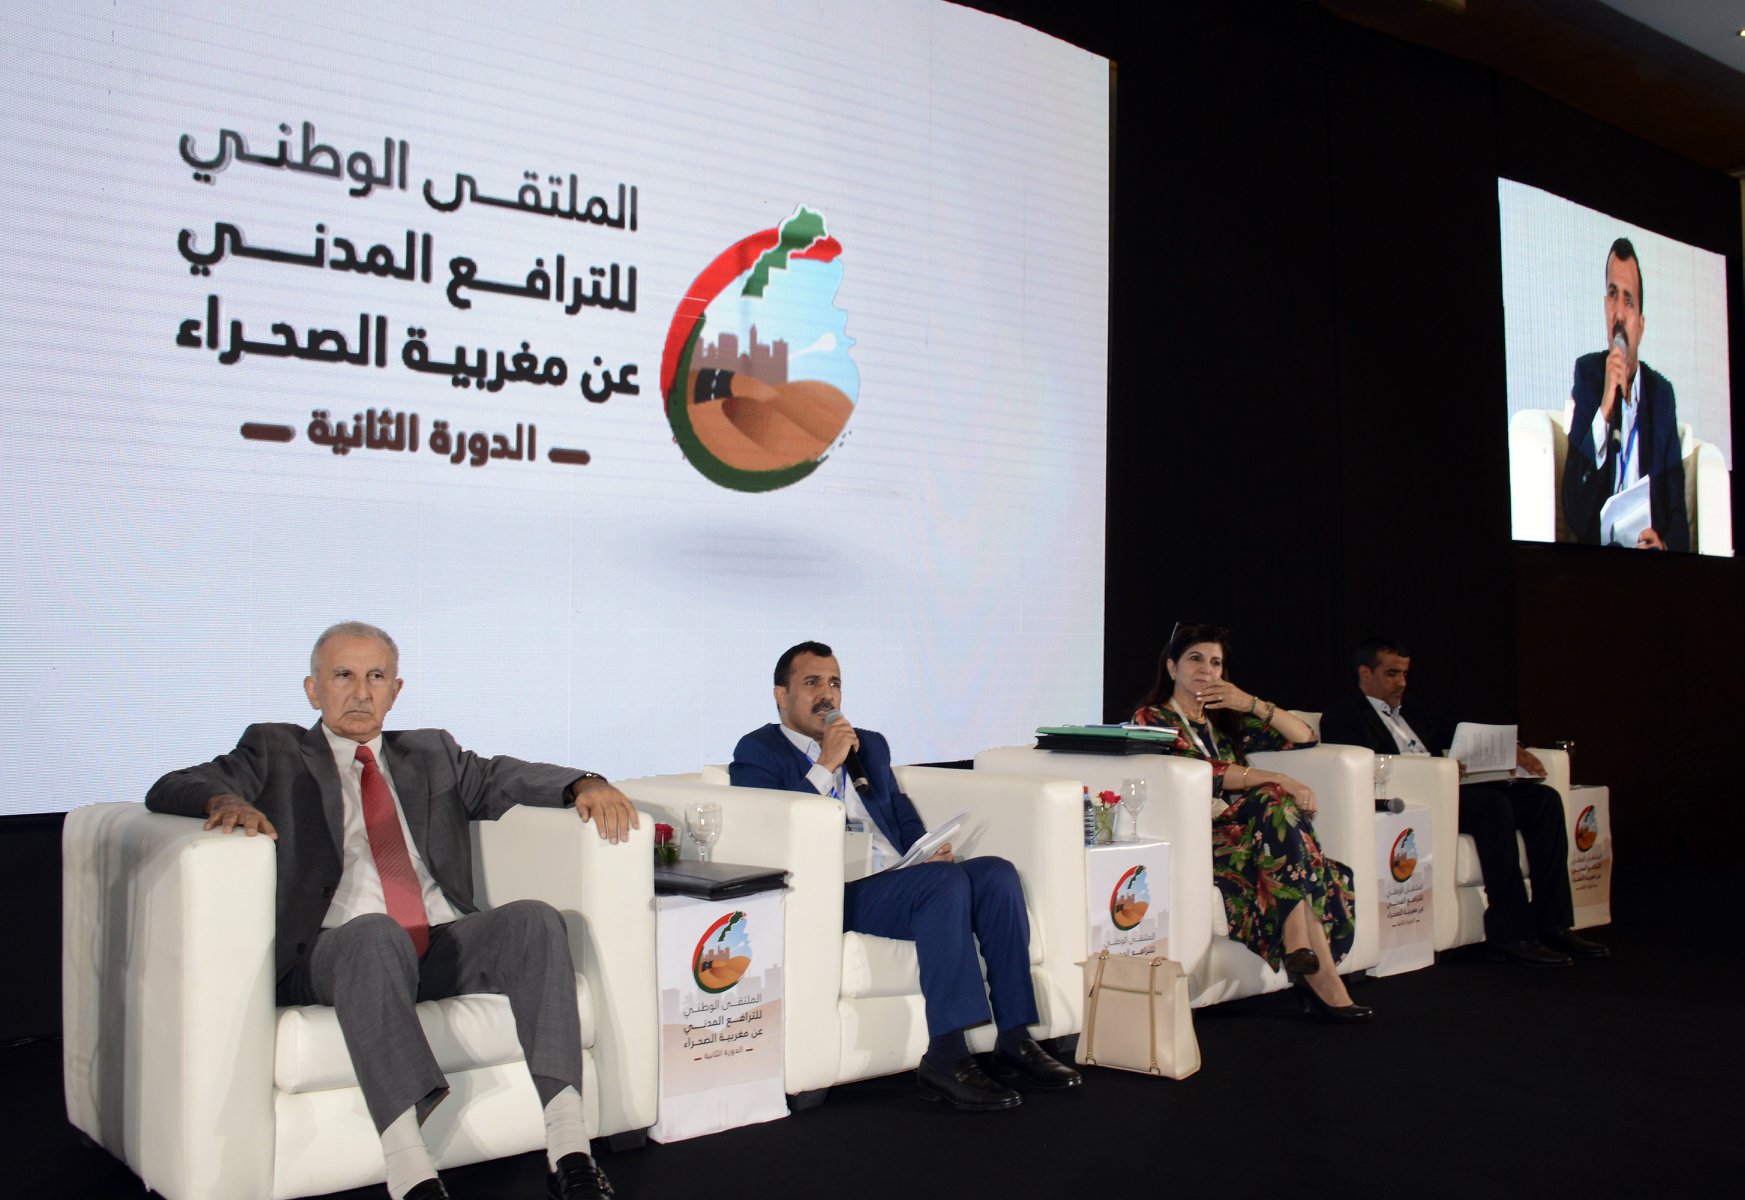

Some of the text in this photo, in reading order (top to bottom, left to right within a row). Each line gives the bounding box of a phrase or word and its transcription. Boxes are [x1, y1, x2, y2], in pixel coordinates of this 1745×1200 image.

[179, 120, 638, 232] الملتقى الوطني
[177, 222, 638, 316] للترافع المدني
[176, 294, 640, 404] عن مغربية الصحراء
[307, 407, 537, 467] الدورة الثانية
[683, 994, 762, 1018] الملتقى الوطني
[683, 1009, 762, 1036] للترافع المدني
[684, 1032, 717, 1049] الصحراء
[751, 1028, 763, 1038] عن
